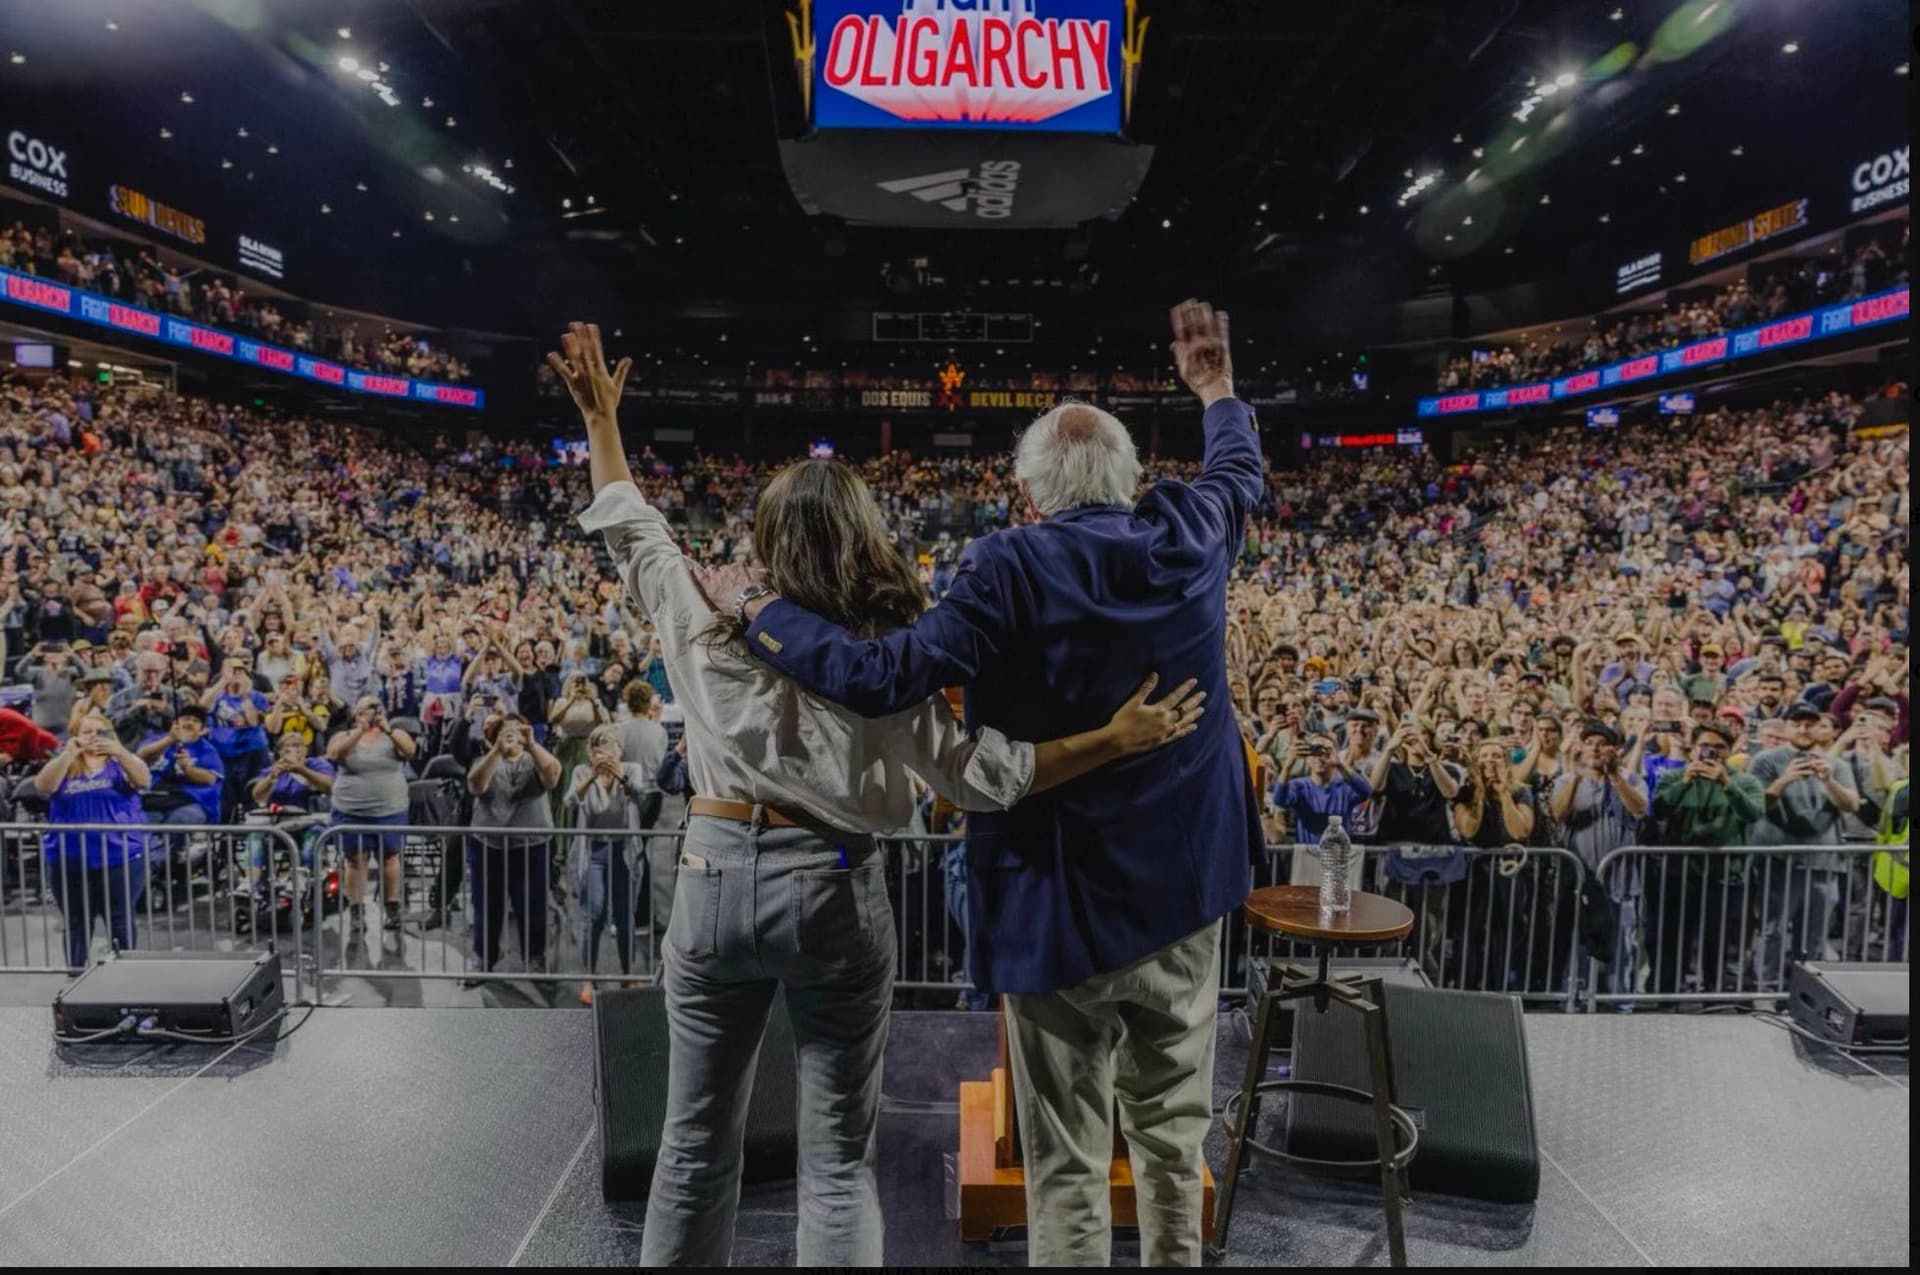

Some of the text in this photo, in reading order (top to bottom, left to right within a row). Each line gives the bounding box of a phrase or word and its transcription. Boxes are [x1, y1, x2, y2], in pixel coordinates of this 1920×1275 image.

[825, 14, 1111, 91] OLIGARCHY
[8, 130, 67, 178] COX
[1853, 145, 1909, 191] COX
[9, 162, 68, 197] BUSINESS
[967, 160, 1021, 218] adidas
[1852, 177, 1909, 213] BUSINESS
[861, 390, 931, 407] DOS EQUIS
[970, 391, 1012, 408] DEVIL
